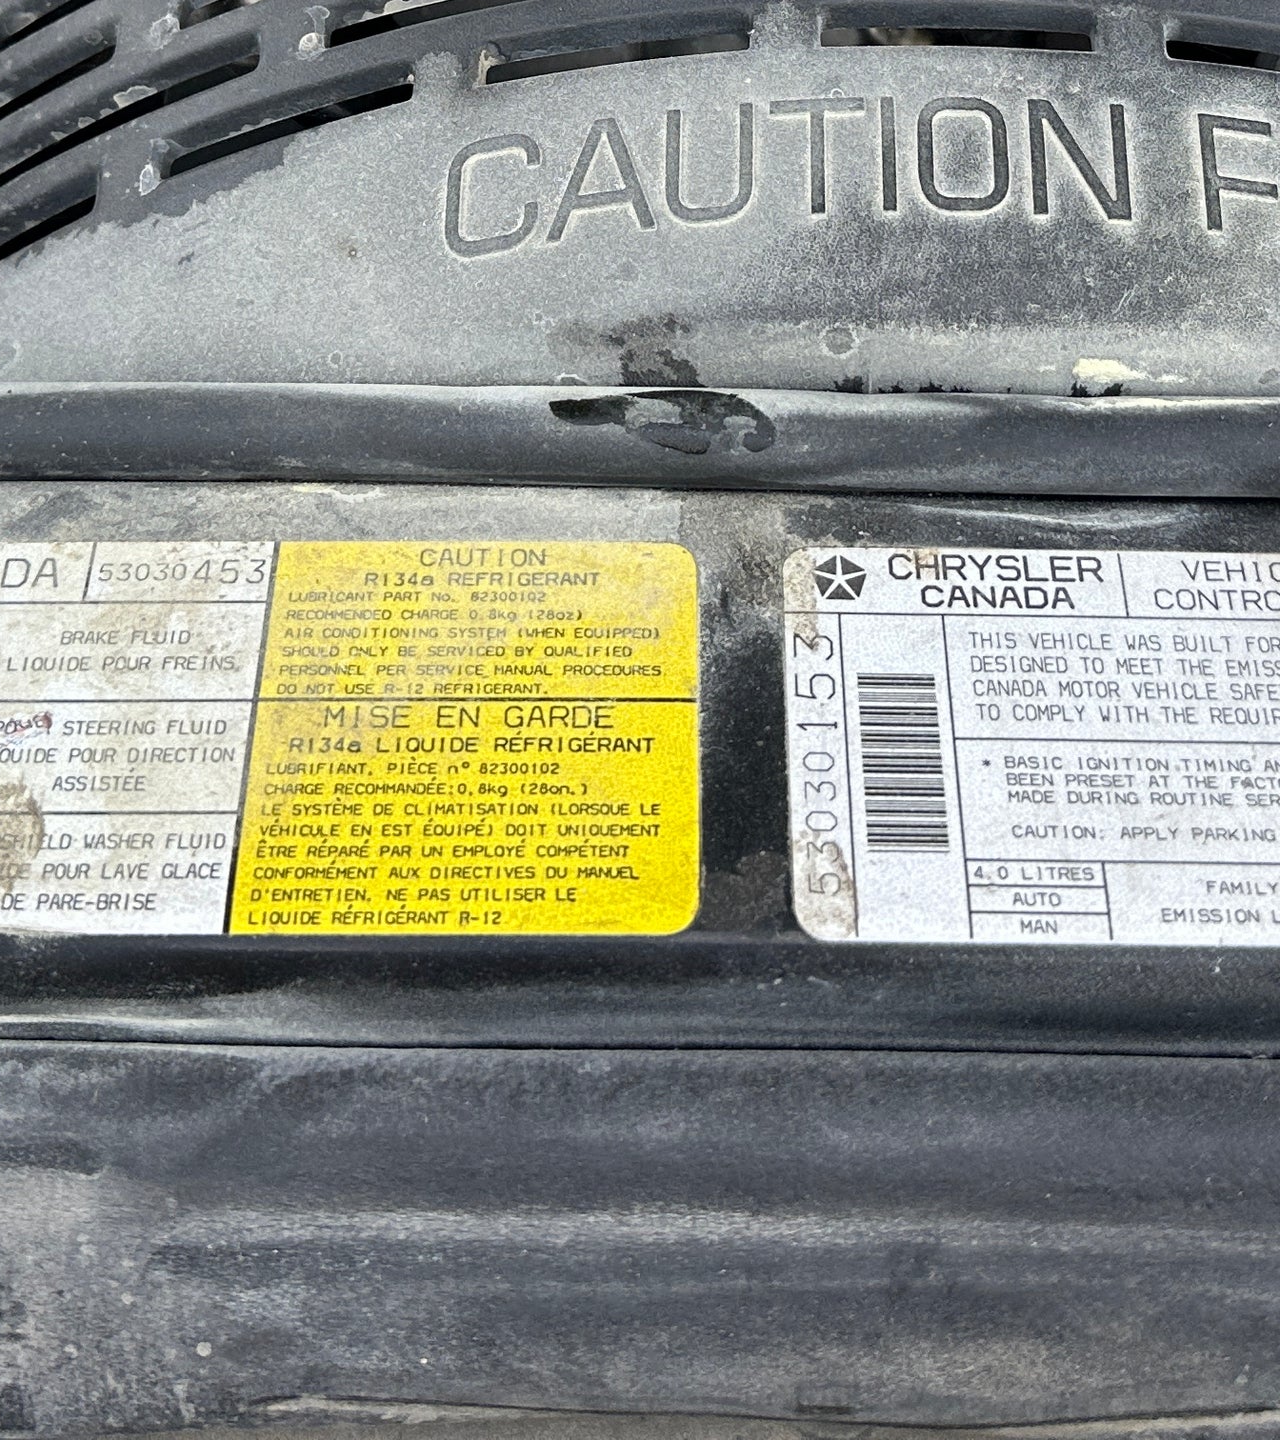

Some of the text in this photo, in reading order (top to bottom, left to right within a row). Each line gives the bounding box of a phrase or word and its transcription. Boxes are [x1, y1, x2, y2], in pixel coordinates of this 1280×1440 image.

[443, 94, 1132, 259] CAUTION
[419, 548, 548, 567] CAUTION
[98, 558, 266, 584] 53030453
[888, 554, 1103, 582] CHRYSLER
[364, 572, 601, 587] R134a REFRIGERANT
[920, 586, 1075, 609] CANADA
[60, 630, 194, 645] BRAKE FLUID
[968, 632, 1017, 649] THIS
[1028, 632, 1113, 651] VEHICLE
[1124, 634, 1162, 652] WAS
[1172, 635, 1231, 653] BUILT
[6, 656, 91, 672] LIQUIDE
[101, 656, 152, 671] POUR
[324, 705, 615, 729] MISE EN GARDE
[62, 720, 156, 736] STEERING
[166, 720, 227, 735] FLUID
[289, 732, 655, 753] R134a LIQUIDE RÉFRIGÉRANT
[68, 747, 117, 763] POUR
[127, 747, 235, 763] DIRECTION
[387, 756, 438, 775] PIÈCE
[479, 762, 560, 775] 82300102
[793, 634, 842, 897] 53030153
[51, 768, 146, 792] ASSISTÉE
[83, 833, 155, 850] WASHER
[165, 833, 226, 850] FLUID
[41, 863, 91, 880] POUR
[100, 863, 150, 880] LAVE
[161, 862, 222, 880] GLACE
[1021, 866, 1095, 881] LITRES
[250, 887, 577, 903] D'ENTRETIEN. NE PAS UTILISER LE
[1206, 880, 1276, 896] FAMILY
[0, 892, 157, 911] DE PARE-BRISE
[1012, 892, 1062, 907] AUTO
[248, 905, 502, 925] LIQUIDE RÉFRIGÉRANT R-12
[1161, 908, 1261, 924] EMISSION
[1020, 919, 1058, 934] MAN
